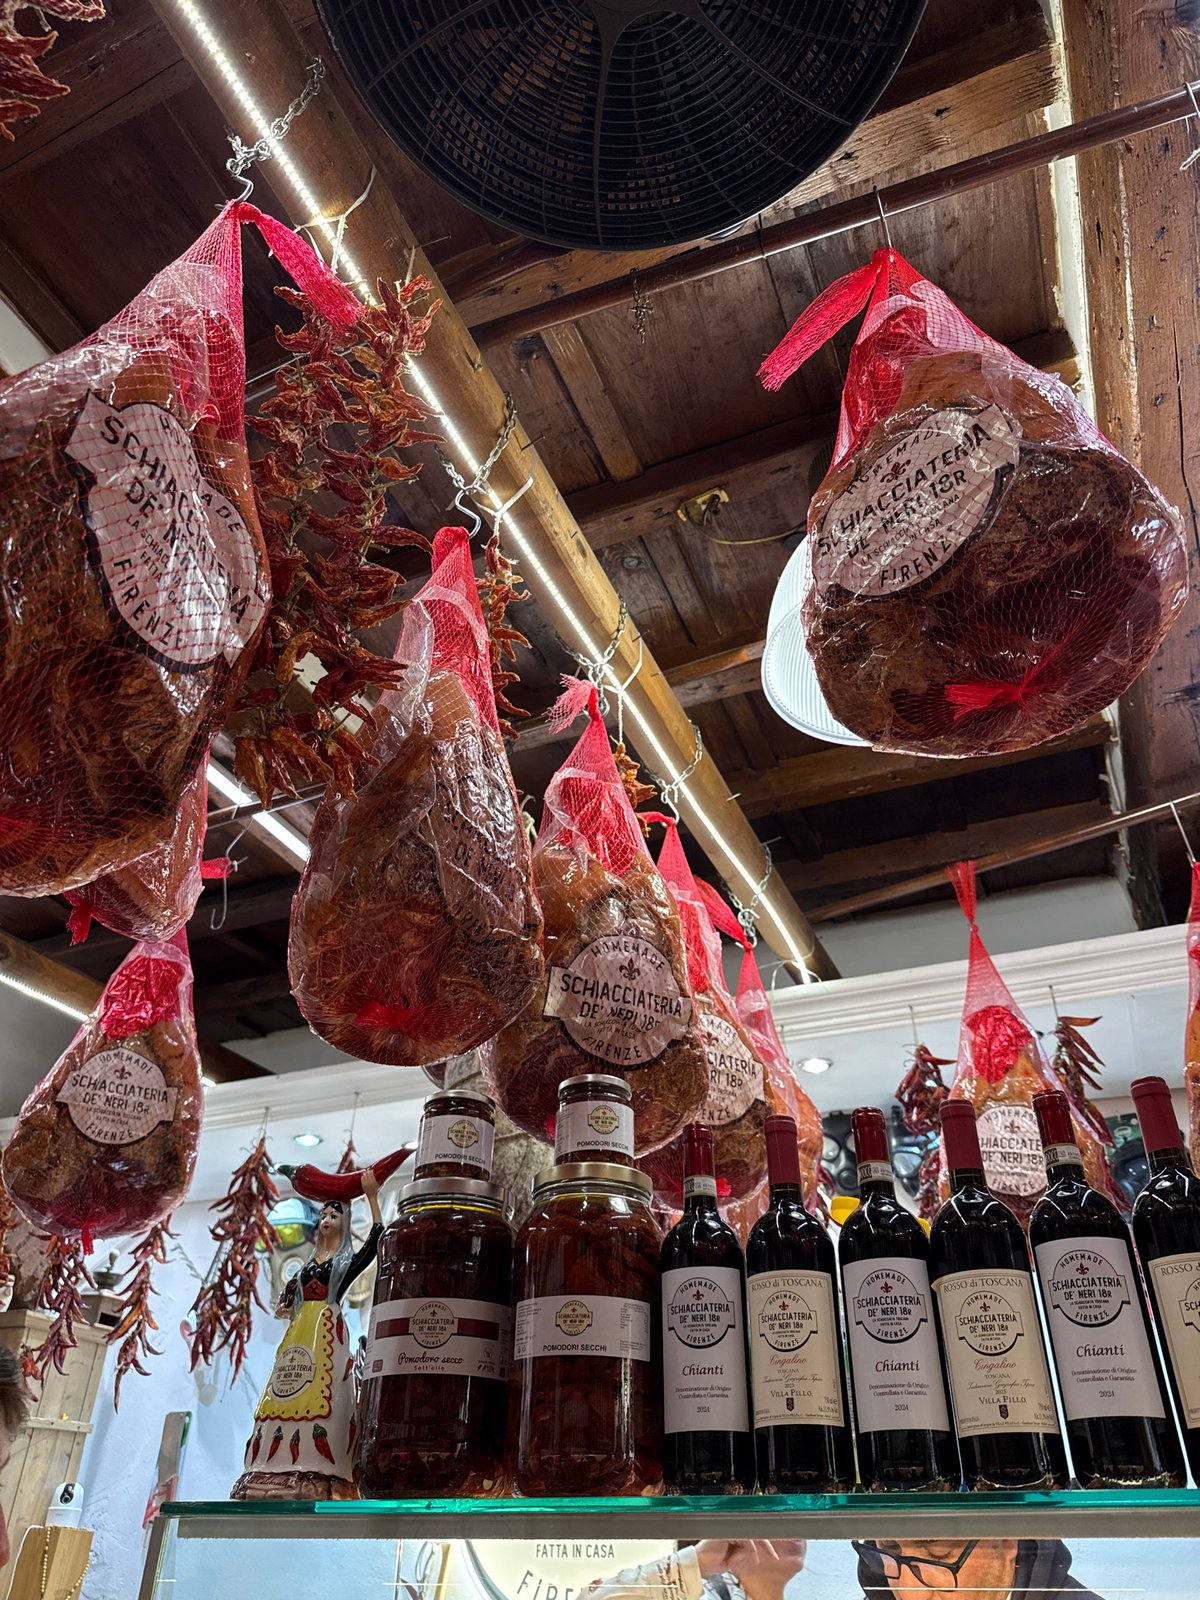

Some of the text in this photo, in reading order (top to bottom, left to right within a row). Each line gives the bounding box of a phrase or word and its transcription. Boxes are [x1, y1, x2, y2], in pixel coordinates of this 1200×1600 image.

[928, 468, 967, 500] 18R
[114, 558, 183, 651] FIRENZE
[591, 940, 665, 972] HOMEMADE
[560, 973, 682, 1018] SCHIACCIATERIA
[579, 1001, 604, 1019] DE'
[581, 1036, 642, 1060] FIRENZE
[71, 1073, 169, 1104] SCHIACCIATERIA
[726, 1073, 743, 1090] 18R
[82, 1092, 150, 1115] DE' NERI 18R
[86, 1122, 134, 1141] FIRENZE
[577, 1140, 610, 1148] POMODORI
[1000, 1151, 1023, 1164] NERI
[991, 1177, 1037, 1193] FIRENZE
[1059, 1253, 1103, 1269] HOMEMADE
[1160, 1262, 1193, 1277] ROSSO
[751, 1277, 823, 1293] ROSSO di TOSCANA
[866, 1272, 907, 1287] HOMEMADE
[943, 1277, 1024, 1294] ROSSO di TOSCANA
[1052, 1276, 1122, 1292] SCHIACCIATERIA
[680, 1280, 718, 1295] HOMEMADE
[1063, 1288, 1112, 1301] DE' NERI 18R
[769, 1293, 800, 1306] HOMEMADE
[857, 1295, 921, 1309] SCHIACCIATERIA
[966, 1293, 1003, 1307] HOMEMADE
[670, 1302, 730, 1316] SCHIACCIATERIA
[868, 1306, 912, 1318] DE' NERI 18R
[1075, 1309, 1109, 1322] FIRENZE
[679, 1313, 721, 1325] DE' NERI 18R
[761, 1311, 813, 1324] SCHIACCIATERIA
[958, 1313, 1017, 1326] SCHIACCIATERIA
[778, 1321, 792, 1330] NERI
[792, 1321, 804, 1330] 18R
[877, 1326, 908, 1339] FIRENZE
[969, 1323, 1009, 1334] DE' NERI 18R
[686, 1333, 716, 1344] FIRENZE
[774, 1337, 800, 1348] FIRENZE
[542, 1343, 608, 1352] POMODORI SECCHI
[978, 1340, 1007, 1352] FIRENZE
[1076, 1343, 1125, 1358] Chianti
[398, 1350, 465, 1365] Pomodoro secco
[682, 1363, 724, 1377] Chianti
[875, 1359, 921, 1373] Chianti
[536, 1543, 615, 1559] FATTA IN CASA
